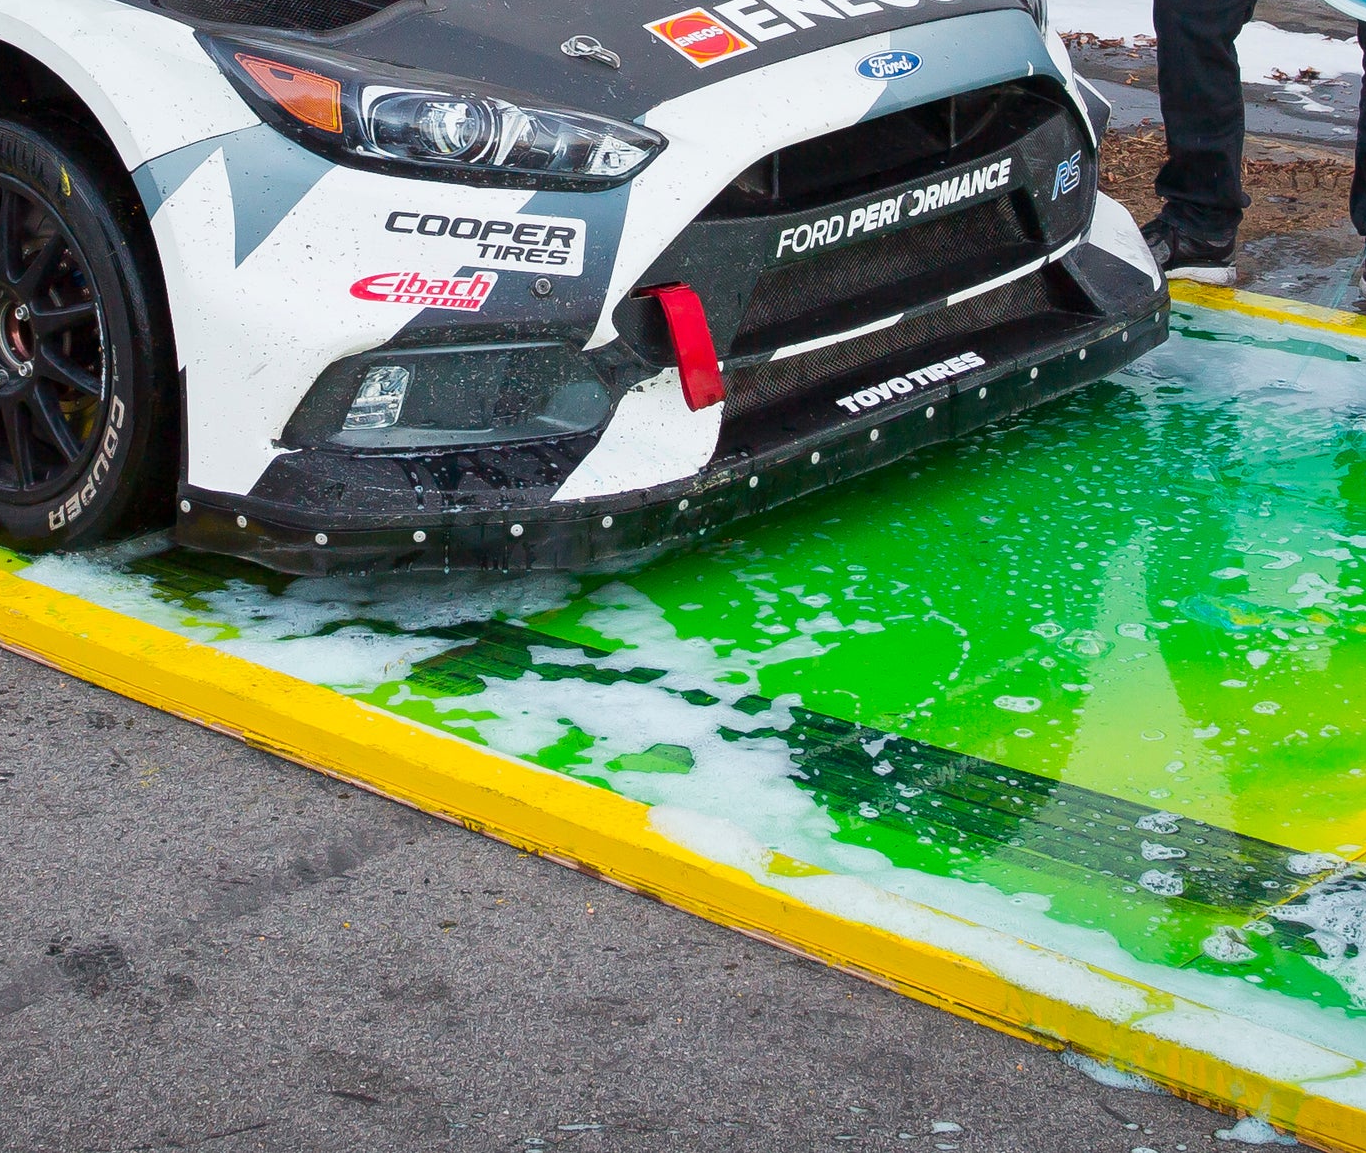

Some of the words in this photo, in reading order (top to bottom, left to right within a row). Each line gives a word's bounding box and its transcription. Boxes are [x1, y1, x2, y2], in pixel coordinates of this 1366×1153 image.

[675, 26, 724, 48] ENEOS
[869, 53, 912, 77] Ford
[1051, 150, 1081, 201] RS
[385, 211, 576, 248] COOPER
[776, 215, 844, 257] FORD
[477, 243, 570, 265] TIRES
[349, 272, 491, 309] Eibach
[836, 377, 913, 412] TOYO
[906, 351, 985, 386] TIRES
